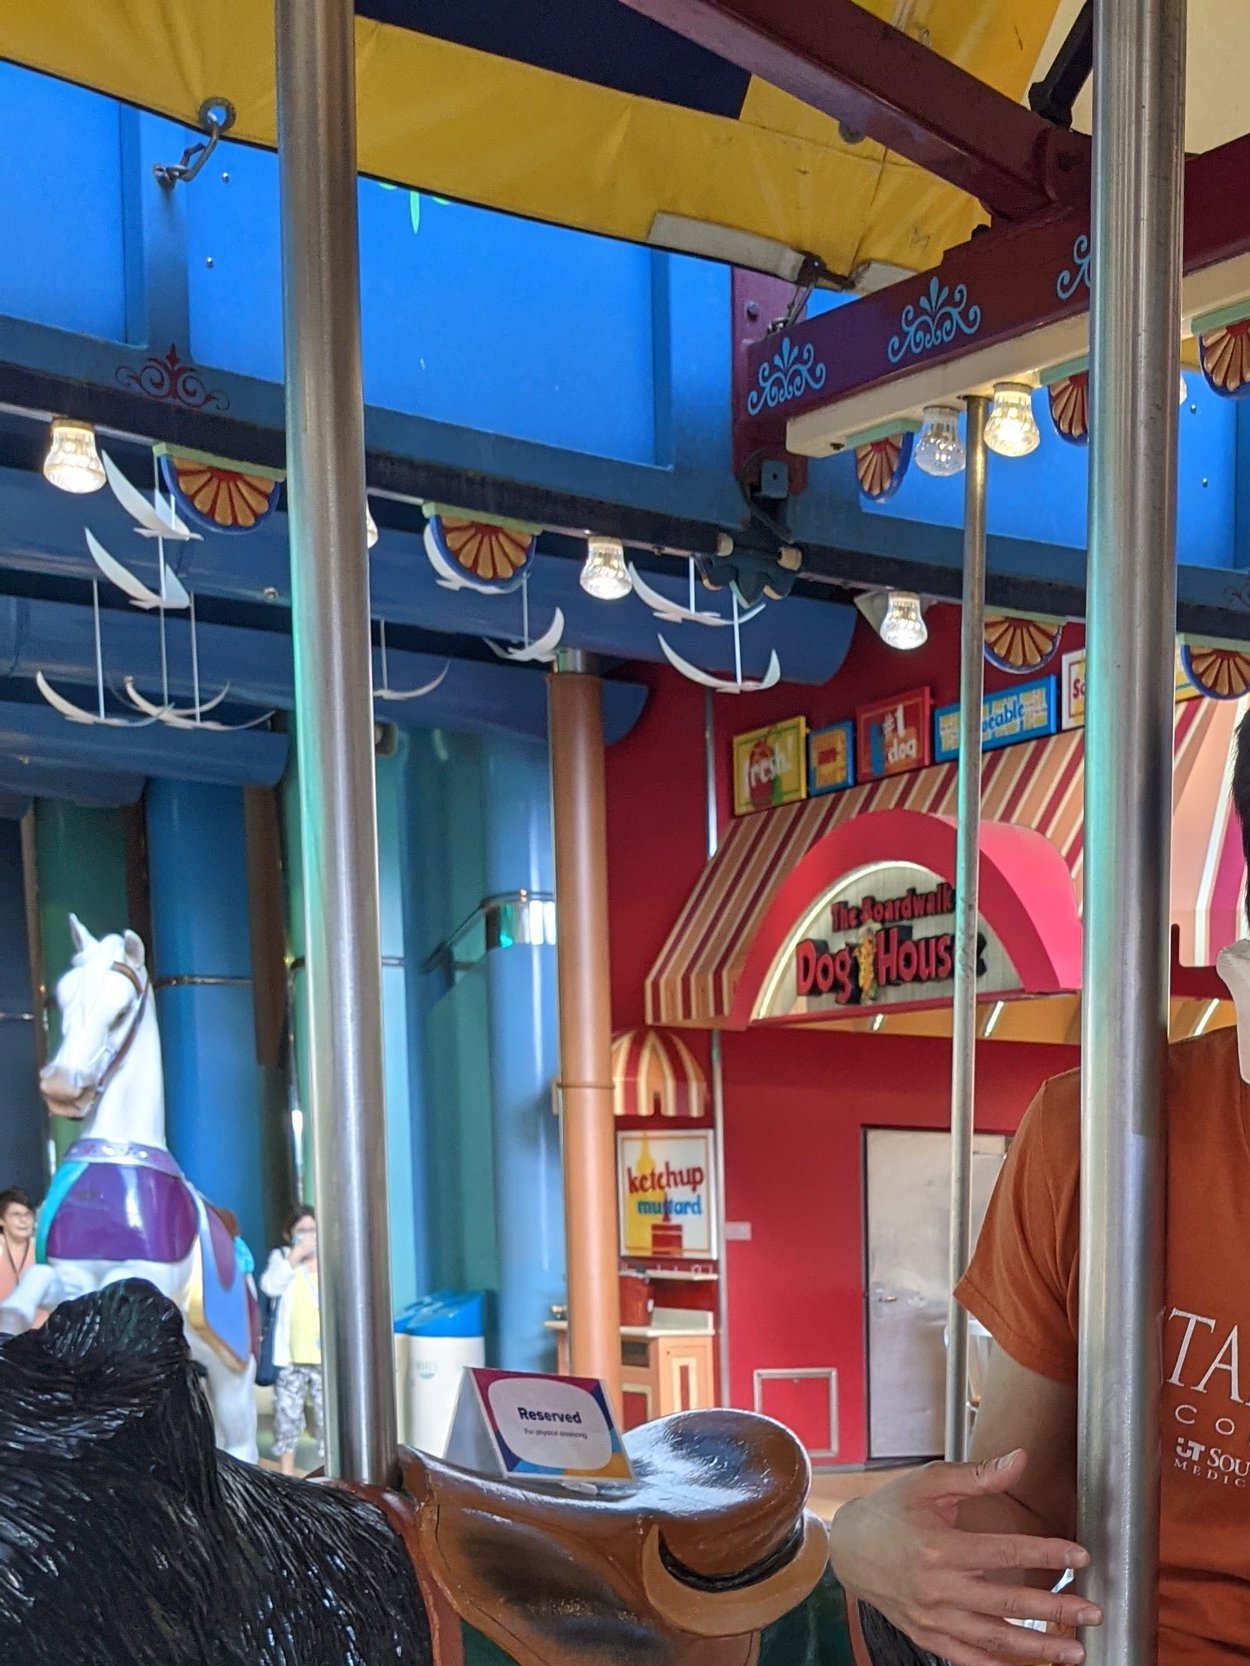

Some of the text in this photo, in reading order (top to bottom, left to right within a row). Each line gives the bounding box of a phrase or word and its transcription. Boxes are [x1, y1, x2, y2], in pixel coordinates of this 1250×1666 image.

[887, 738, 918, 766] dog
[831, 882, 957, 932] The Boardwalk
[796, 925, 986, 1004] Dog Hous
[626, 1160, 705, 1194] ketchup
[517, 1406, 582, 1425] Reserved
